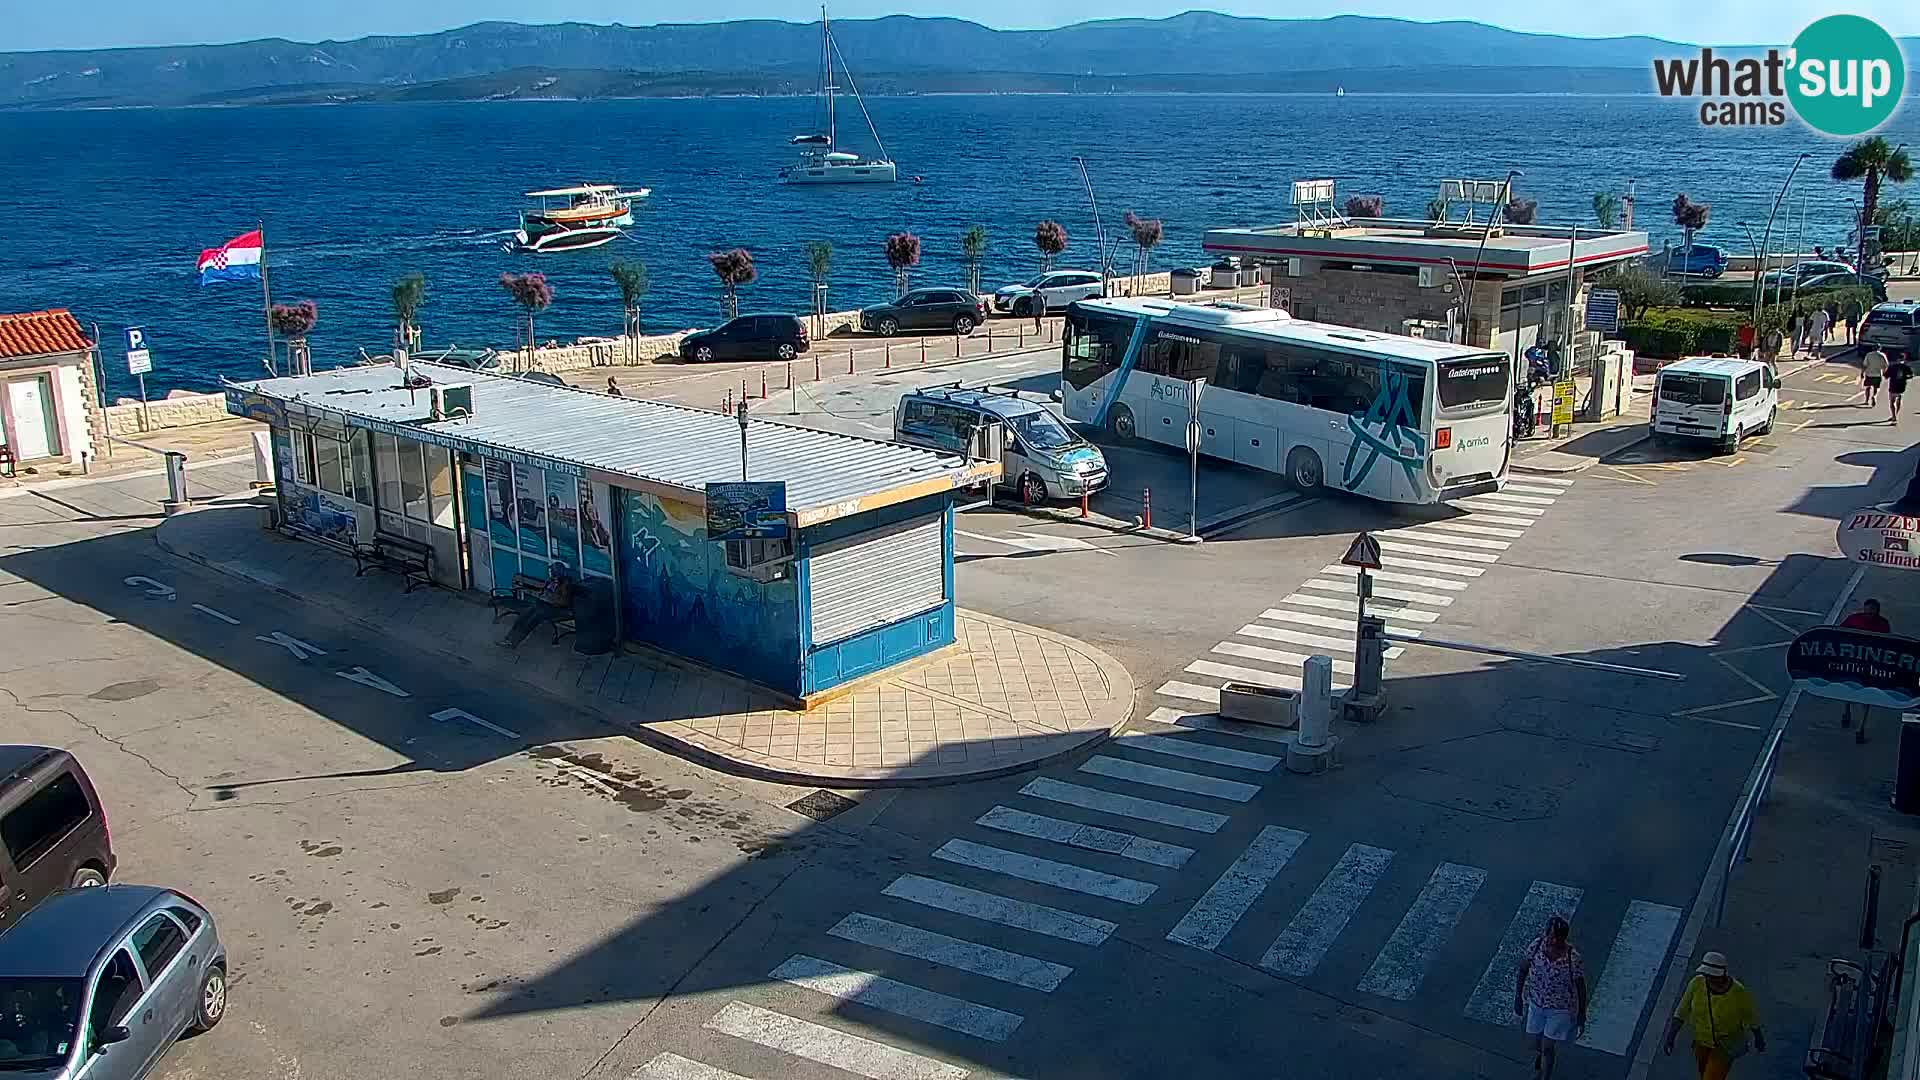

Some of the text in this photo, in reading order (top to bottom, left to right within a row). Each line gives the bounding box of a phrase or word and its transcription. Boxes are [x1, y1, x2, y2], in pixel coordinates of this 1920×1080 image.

[129, 330, 142, 349] P
[1466, 437, 1489, 448] arriva
[478, 445, 492, 457] BUS
[494, 449, 526, 464] STATION
[528, 457, 554, 471] TICKET
[555, 461, 581, 476] OFFICE
[1881, 529, 1915, 539] GRILL
[1800, 640, 1920, 673] MARINER
[1869, 664, 1896, 678] bar
